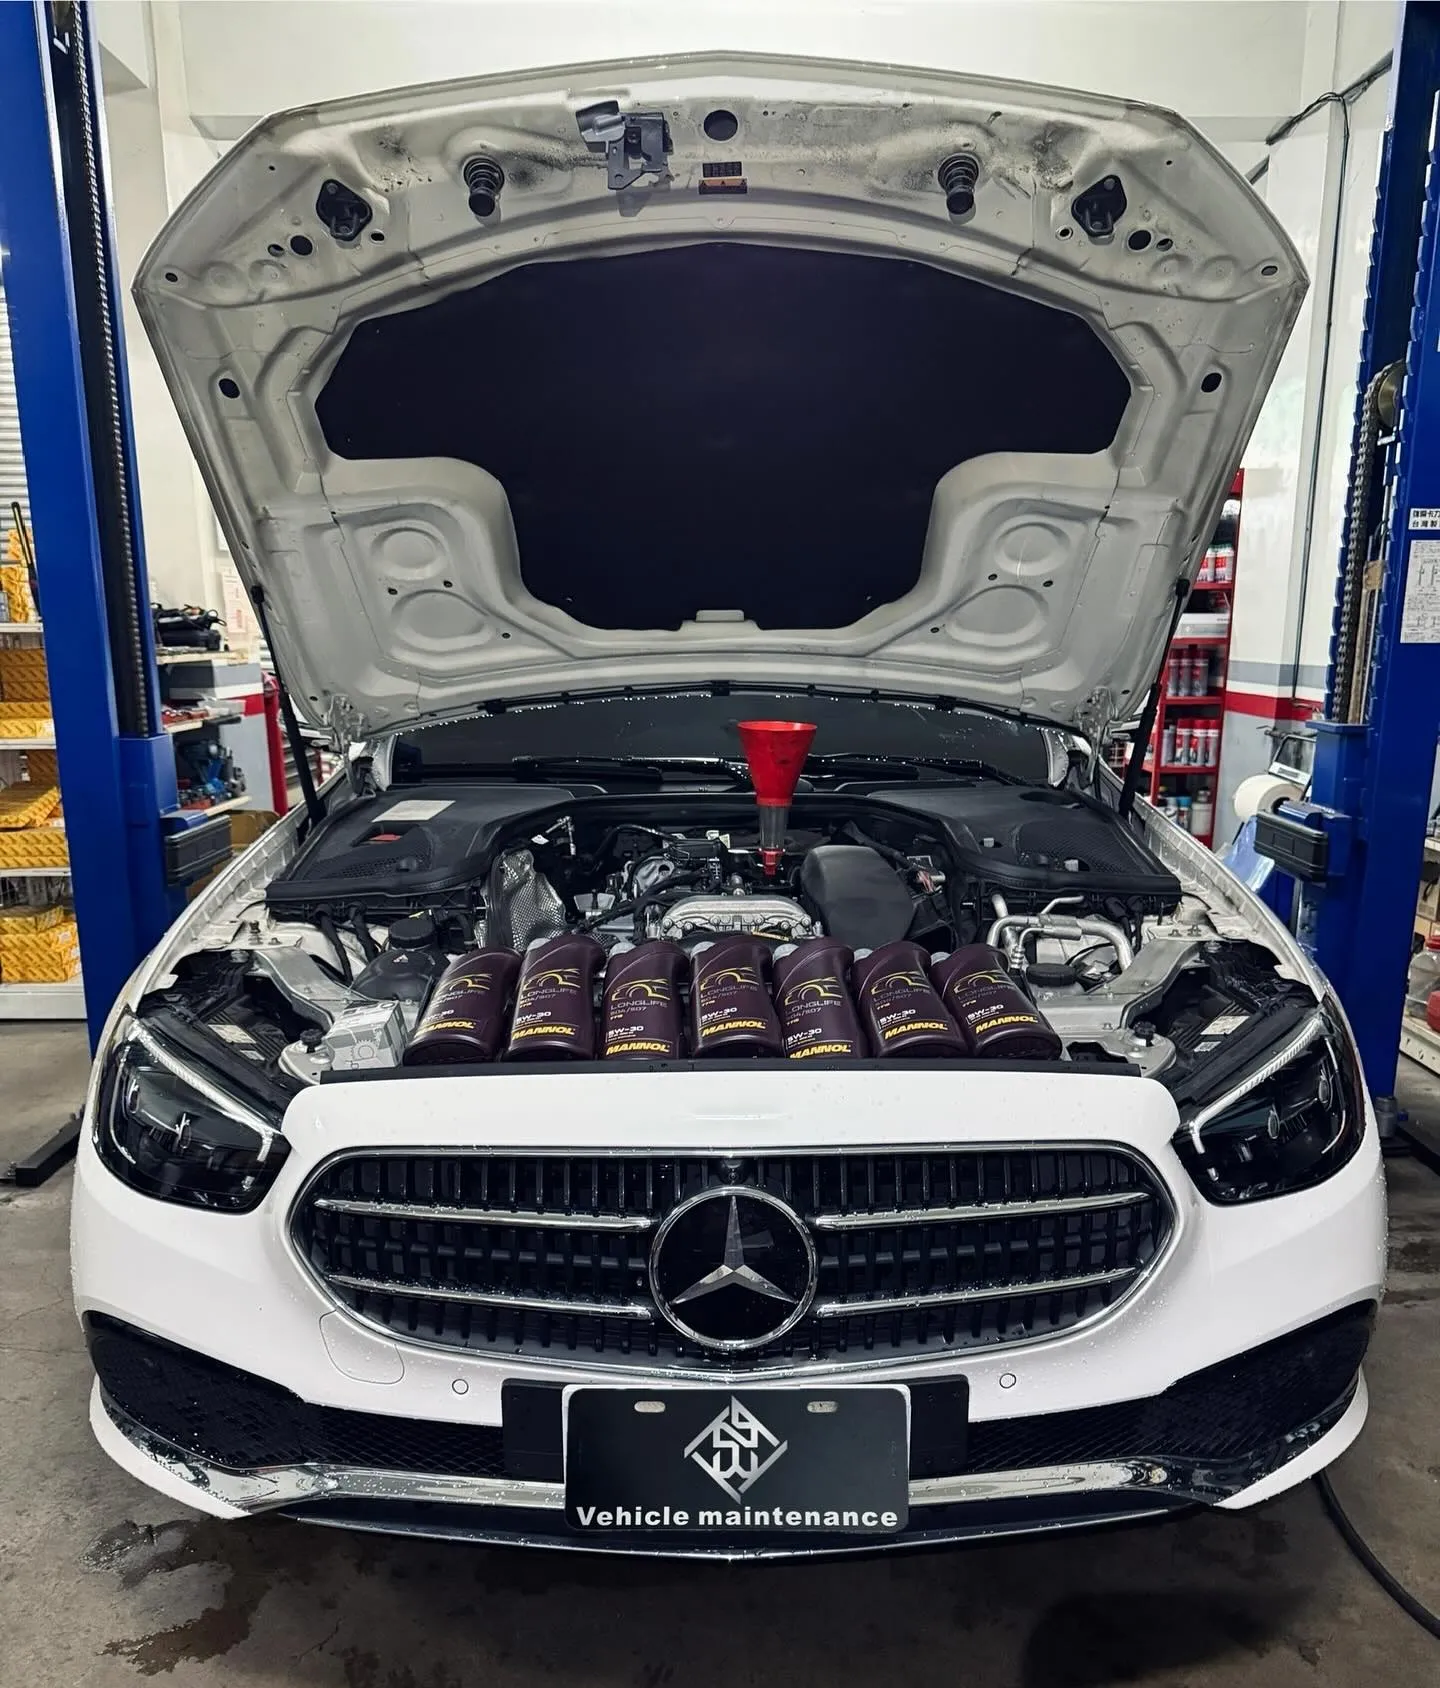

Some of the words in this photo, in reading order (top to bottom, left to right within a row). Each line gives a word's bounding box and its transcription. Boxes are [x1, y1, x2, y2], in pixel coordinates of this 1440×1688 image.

[1412, 520, 1440, 528] 台灣製
[610, 1000, 668, 1010] LONGLIFE
[968, 1004, 1004, 1019] 5W-30
[516, 1011, 552, 1023] 5W-30
[702, 1007, 738, 1020] 5W-30
[880, 1009, 916, 1023] 5W-30
[608, 1025, 644, 1037] 5W-30
[702, 1020, 766, 1037] MANNOL
[885, 1022, 948, 1039] MANNOL
[976, 1015, 1038, 1033] MANNOL
[512, 1026, 575, 1040] MANNOL
[788, 1028, 822, 1042] 5W-30
[606, 1042, 670, 1055] MANNOL
[790, 1044, 851, 1058] MANNOL
[576, 1506, 689, 1526] Vehicle
[699, 1506, 898, 1526] maintenance
